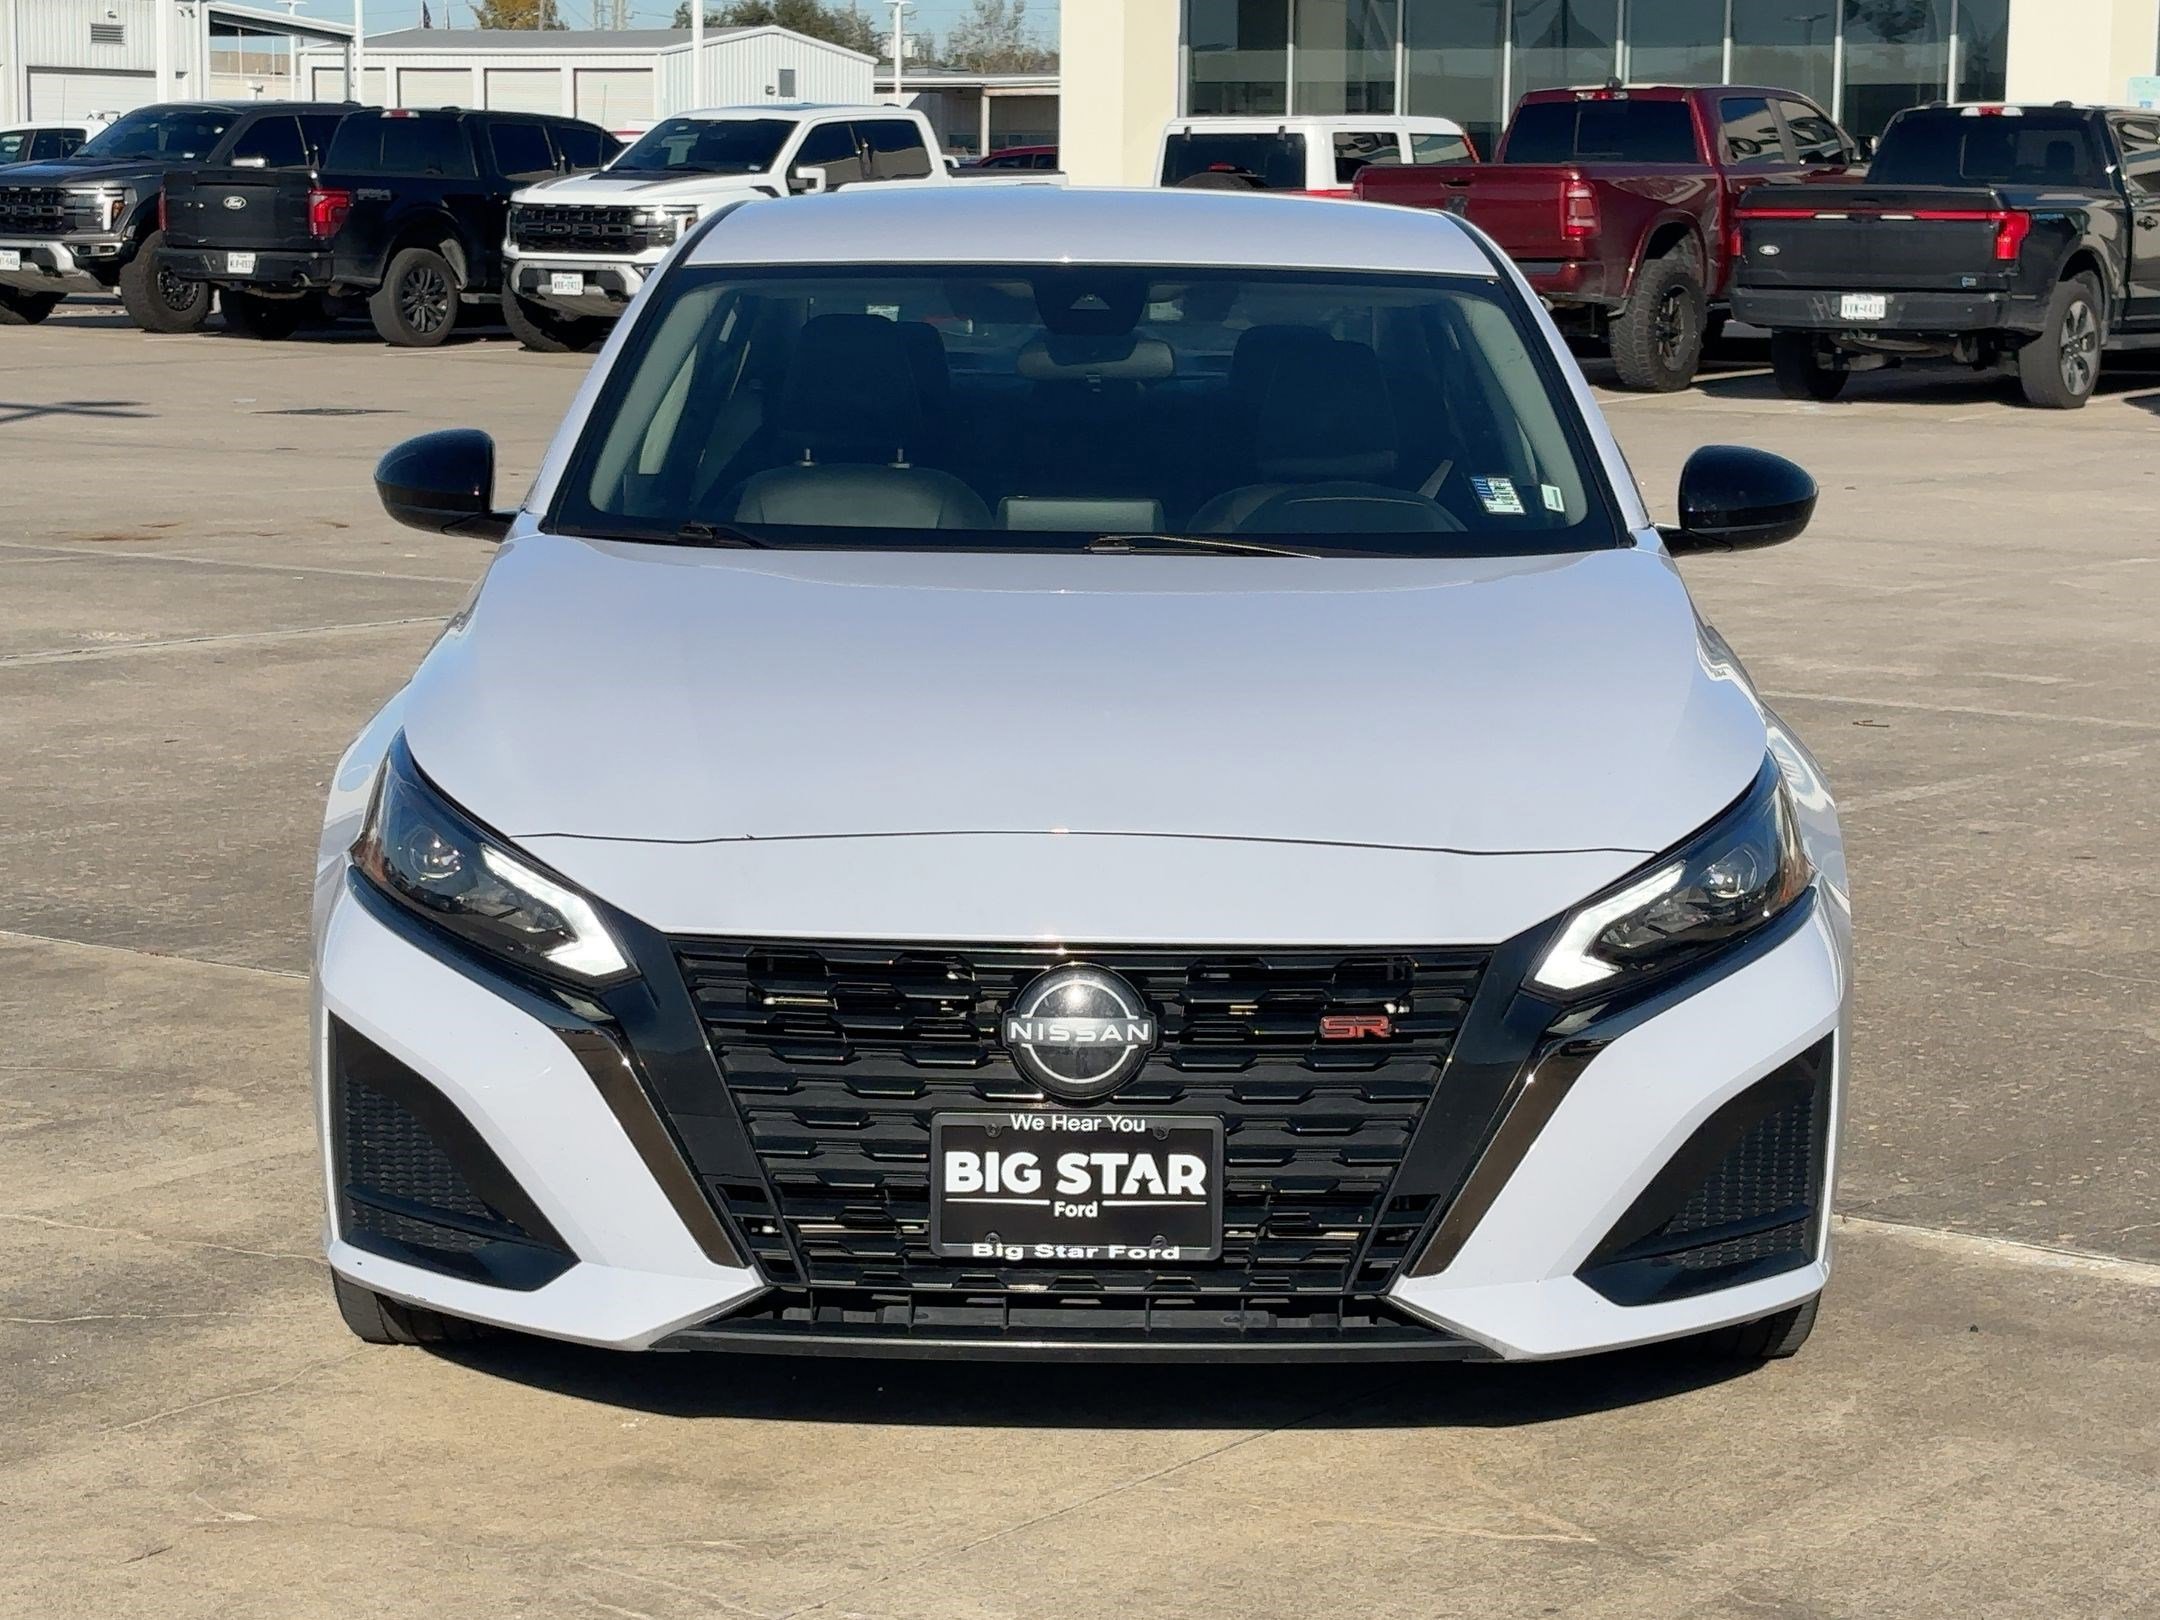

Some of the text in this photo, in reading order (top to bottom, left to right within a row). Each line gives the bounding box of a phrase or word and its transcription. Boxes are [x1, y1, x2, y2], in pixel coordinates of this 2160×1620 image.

[520, 222, 633, 236] FORD
[1010, 1021, 1149, 1042] NISSAN
[1320, 1015, 1391, 1039] SR
[1010, 1114, 1146, 1133] We Hear You
[945, 1151, 1207, 1196] BIG STAR
[1054, 1201, 1098, 1218] Ford
[972, 1243, 1180, 1261] Big Star Ford
